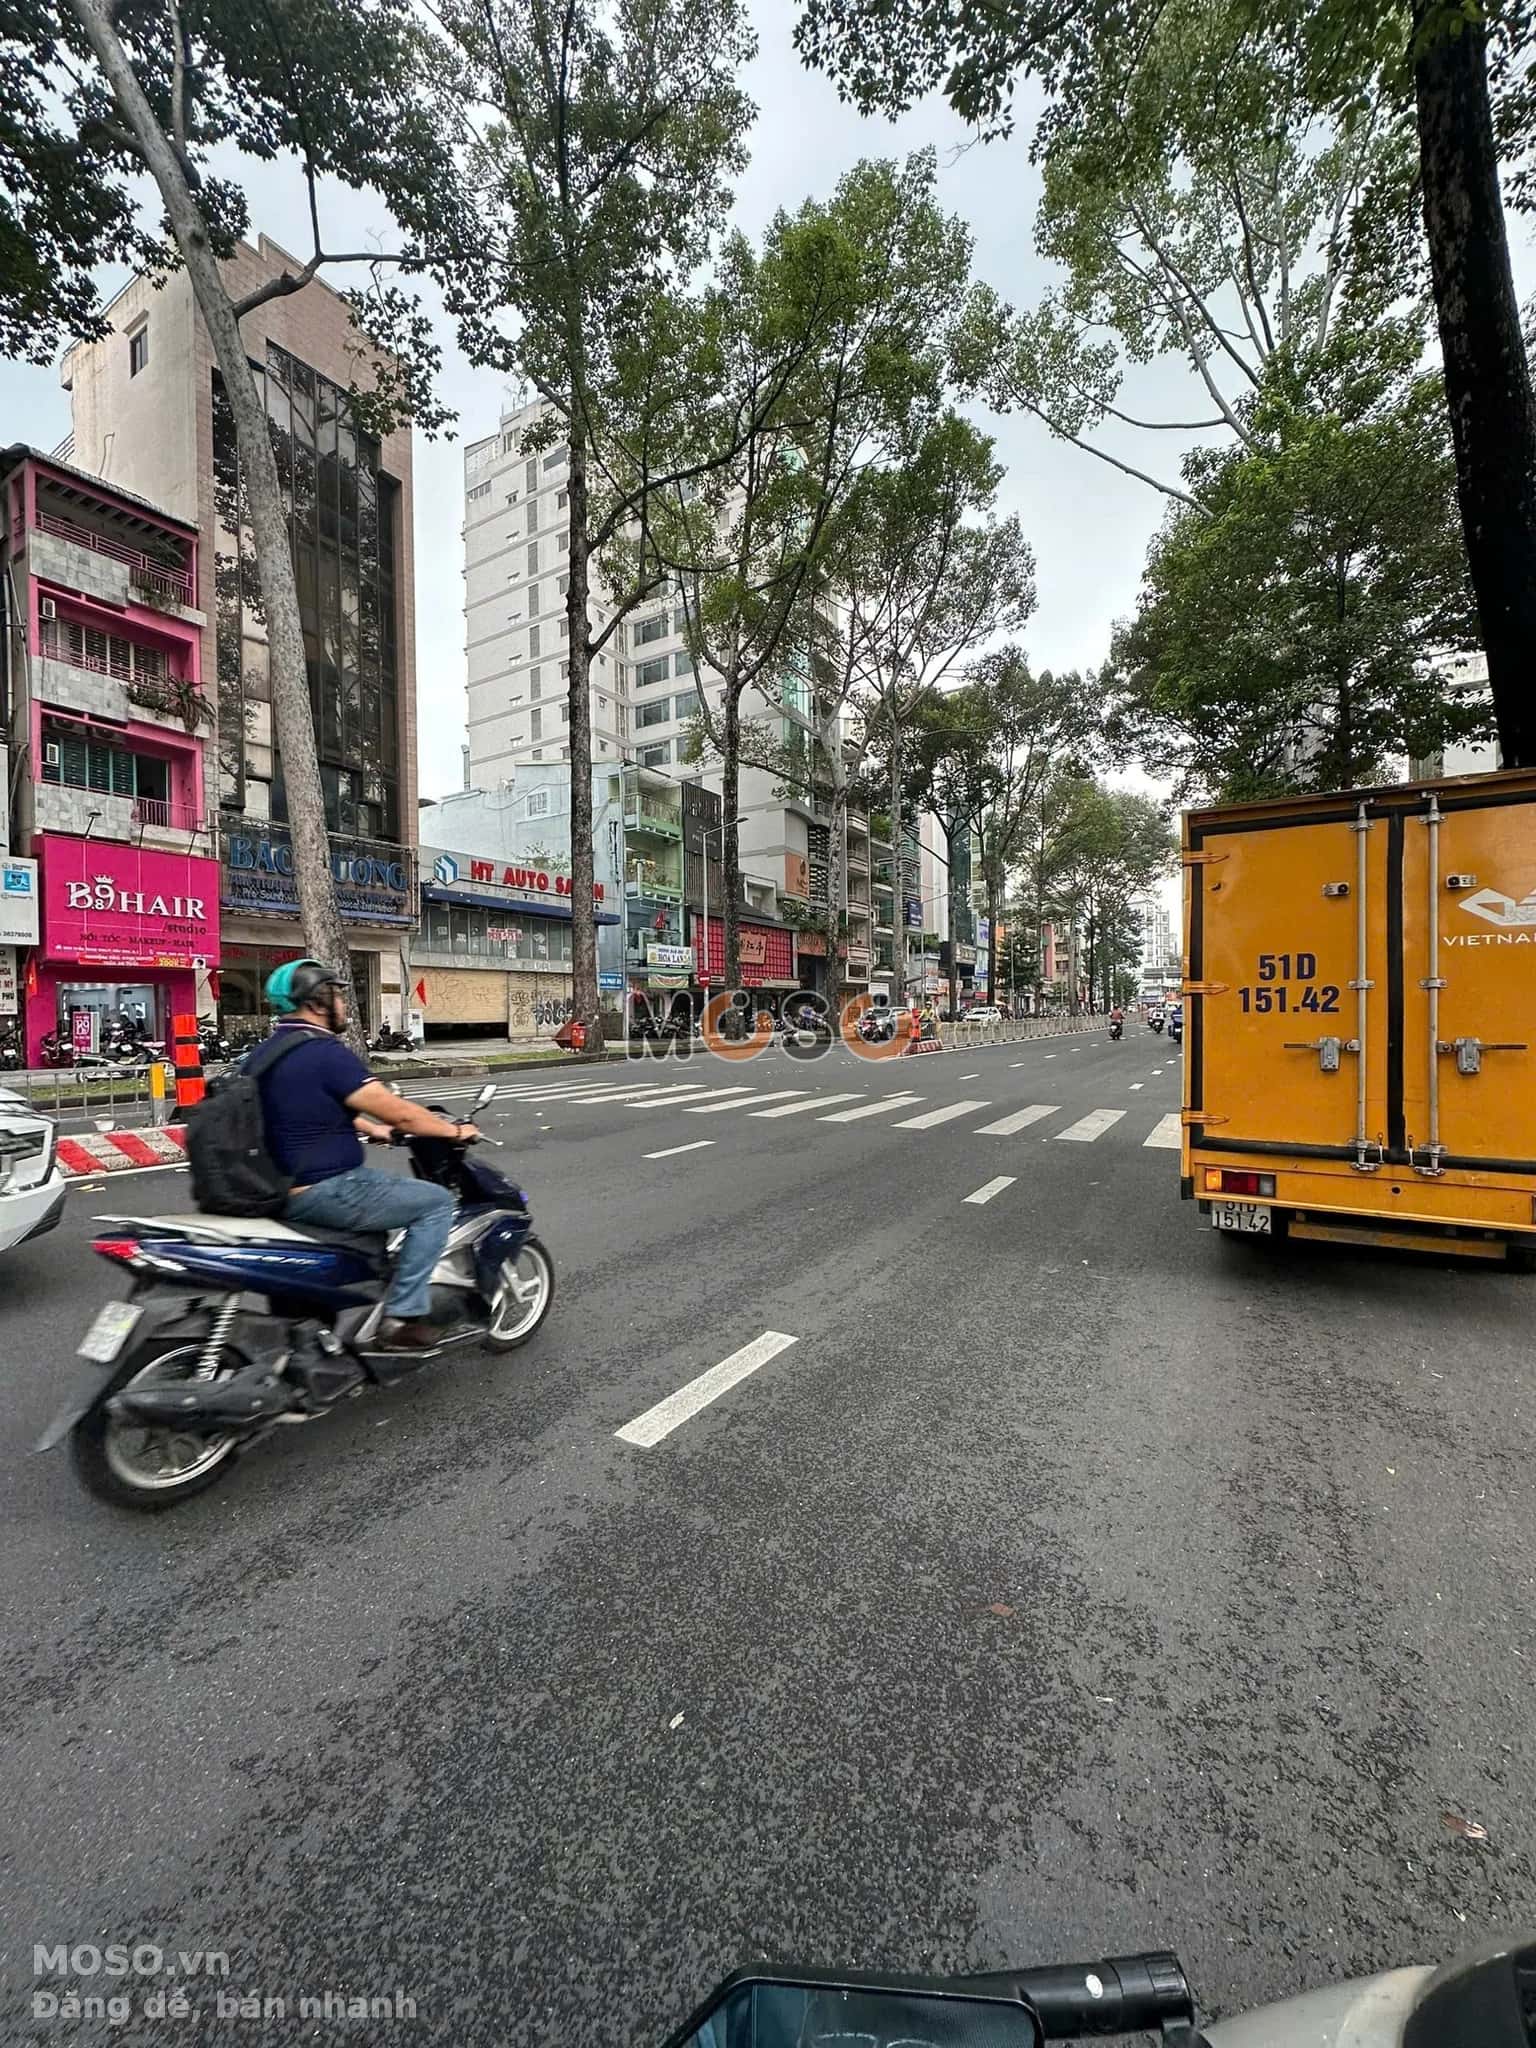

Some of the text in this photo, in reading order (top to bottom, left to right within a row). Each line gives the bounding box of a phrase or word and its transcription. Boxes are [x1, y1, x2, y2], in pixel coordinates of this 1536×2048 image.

[503, 867, 549, 891] AUTO
[118, 891, 207, 920] HAIR
[167, 923, 206, 936] studio
[1443, 932, 1536, 946] VIETNA
[1258, 953, 1316, 981] 51D
[1239, 985, 1340, 1014] 151.42
[1214, 1211, 1270, 1232] 151.42
